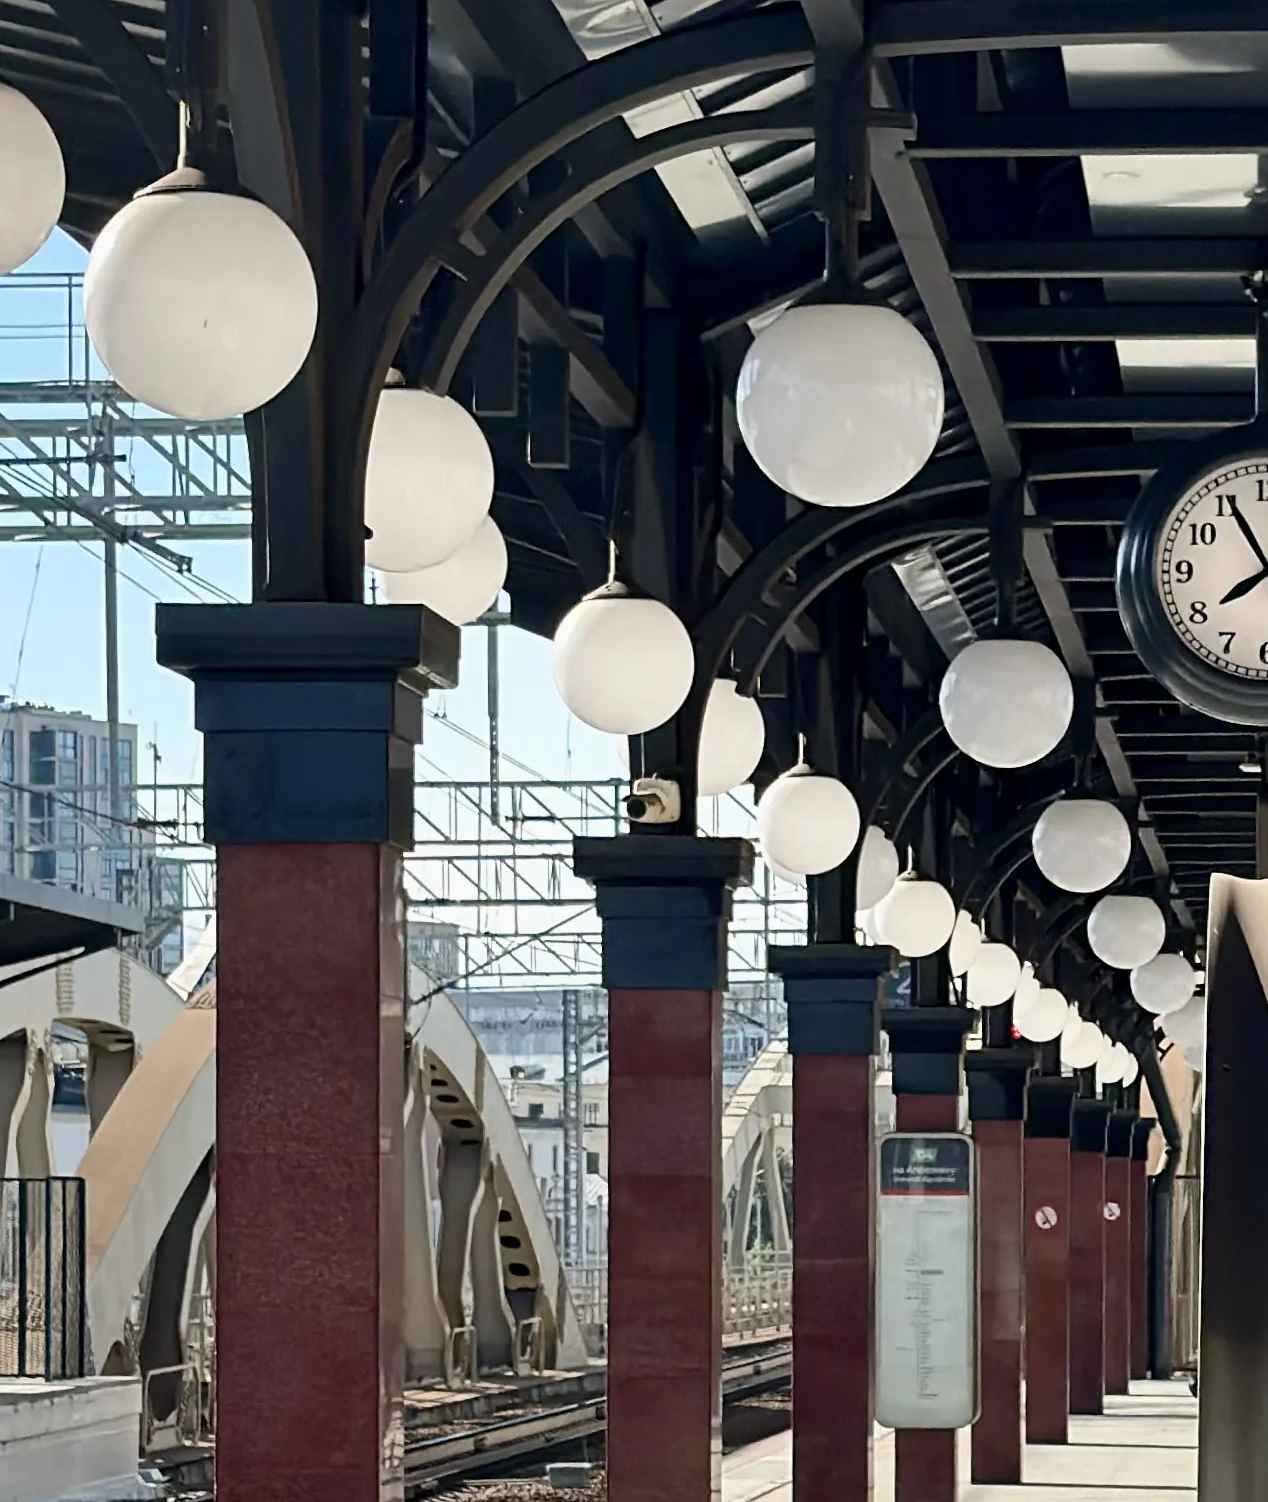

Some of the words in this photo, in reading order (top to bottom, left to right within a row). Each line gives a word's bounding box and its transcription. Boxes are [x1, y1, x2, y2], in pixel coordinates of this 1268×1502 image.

[1189, 523, 1216, 545] 10
[1176, 560, 1193, 583] 9
[1189, 601, 1207, 624] 8
[1219, 632, 1236, 654] 7
